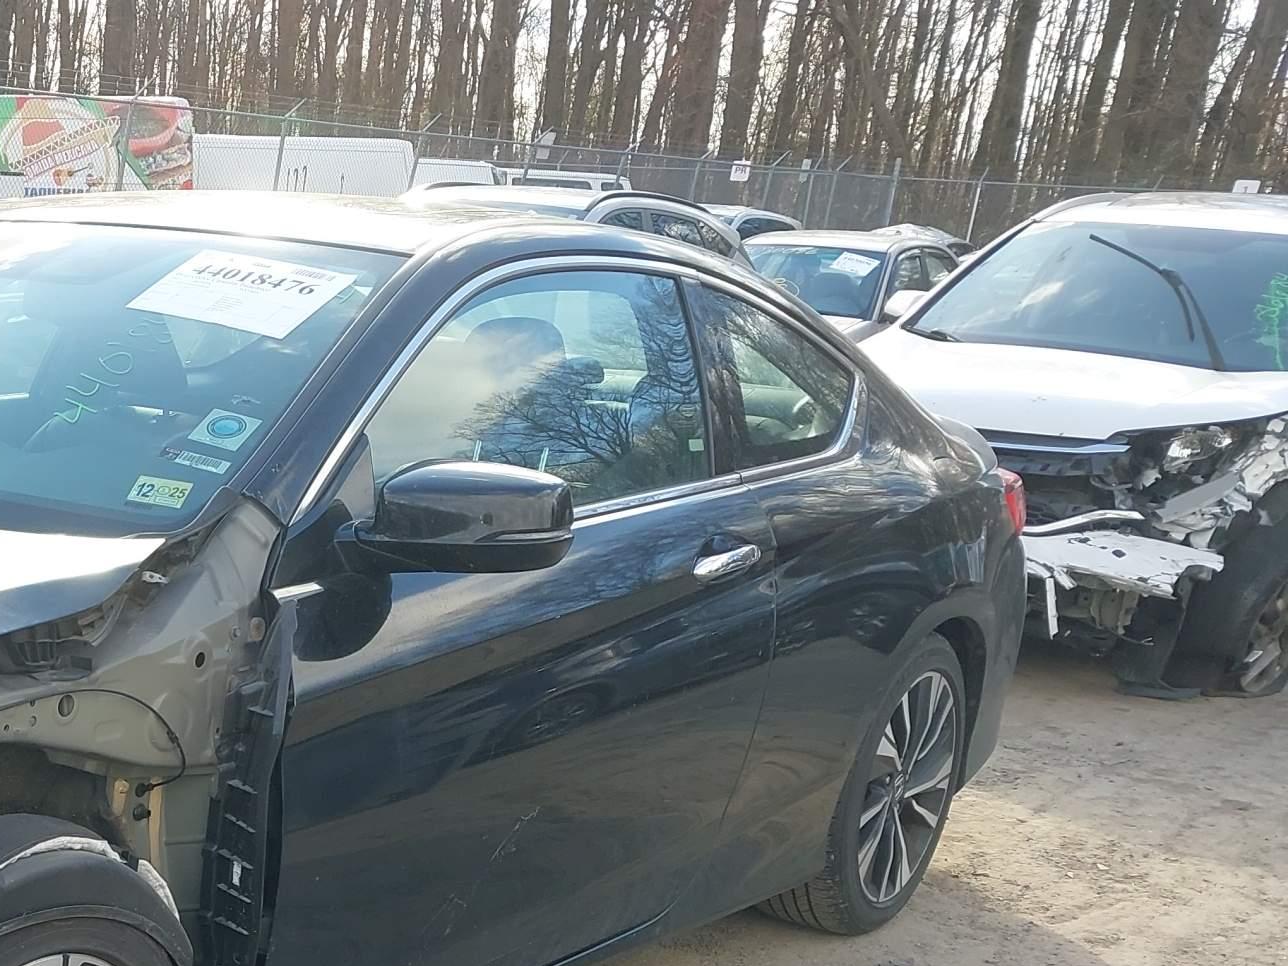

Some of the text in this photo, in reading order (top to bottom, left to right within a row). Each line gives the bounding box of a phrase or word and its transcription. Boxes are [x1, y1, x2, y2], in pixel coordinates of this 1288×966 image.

[192, 264, 321, 296] 44018476
[136, 482, 188, 500] 12 25
